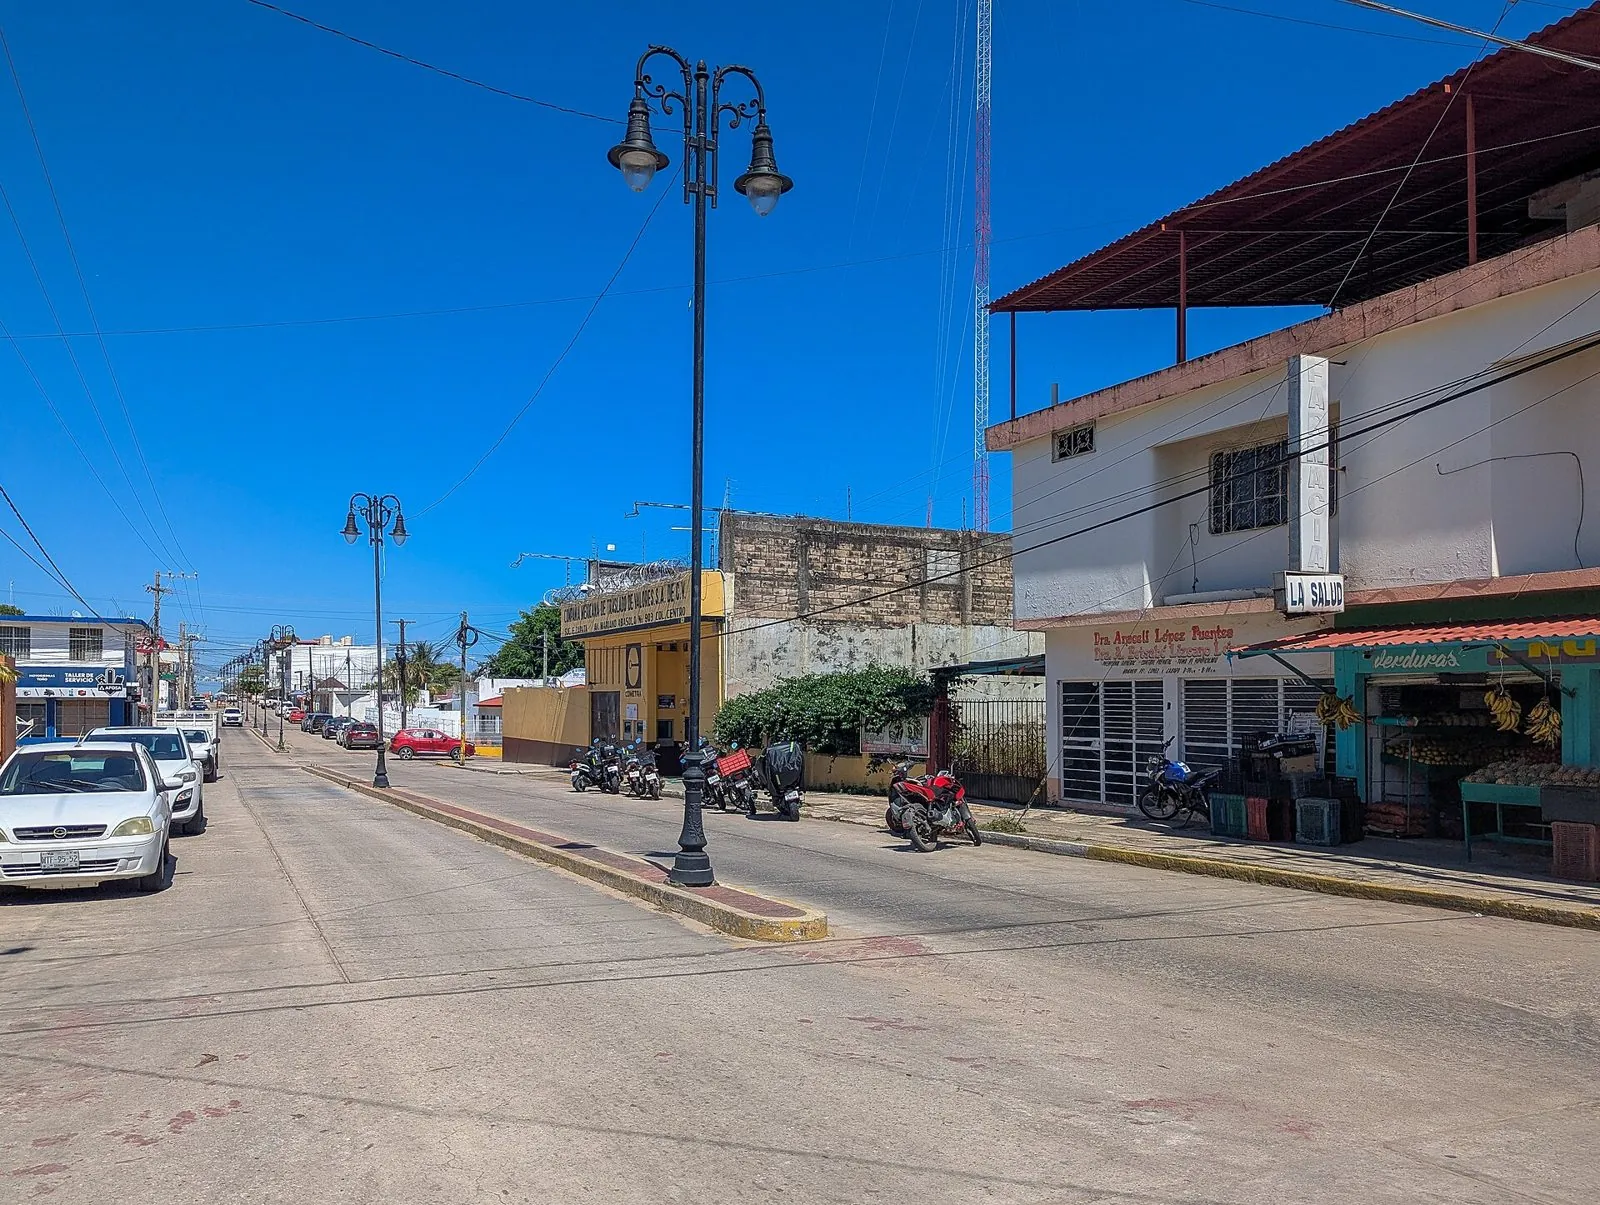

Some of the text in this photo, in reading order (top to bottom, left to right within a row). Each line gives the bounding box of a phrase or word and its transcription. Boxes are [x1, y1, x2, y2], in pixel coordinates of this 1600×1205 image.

[1290, 581, 1343, 607] LA SALUD
[667, 606, 686, 619] CENTRO
